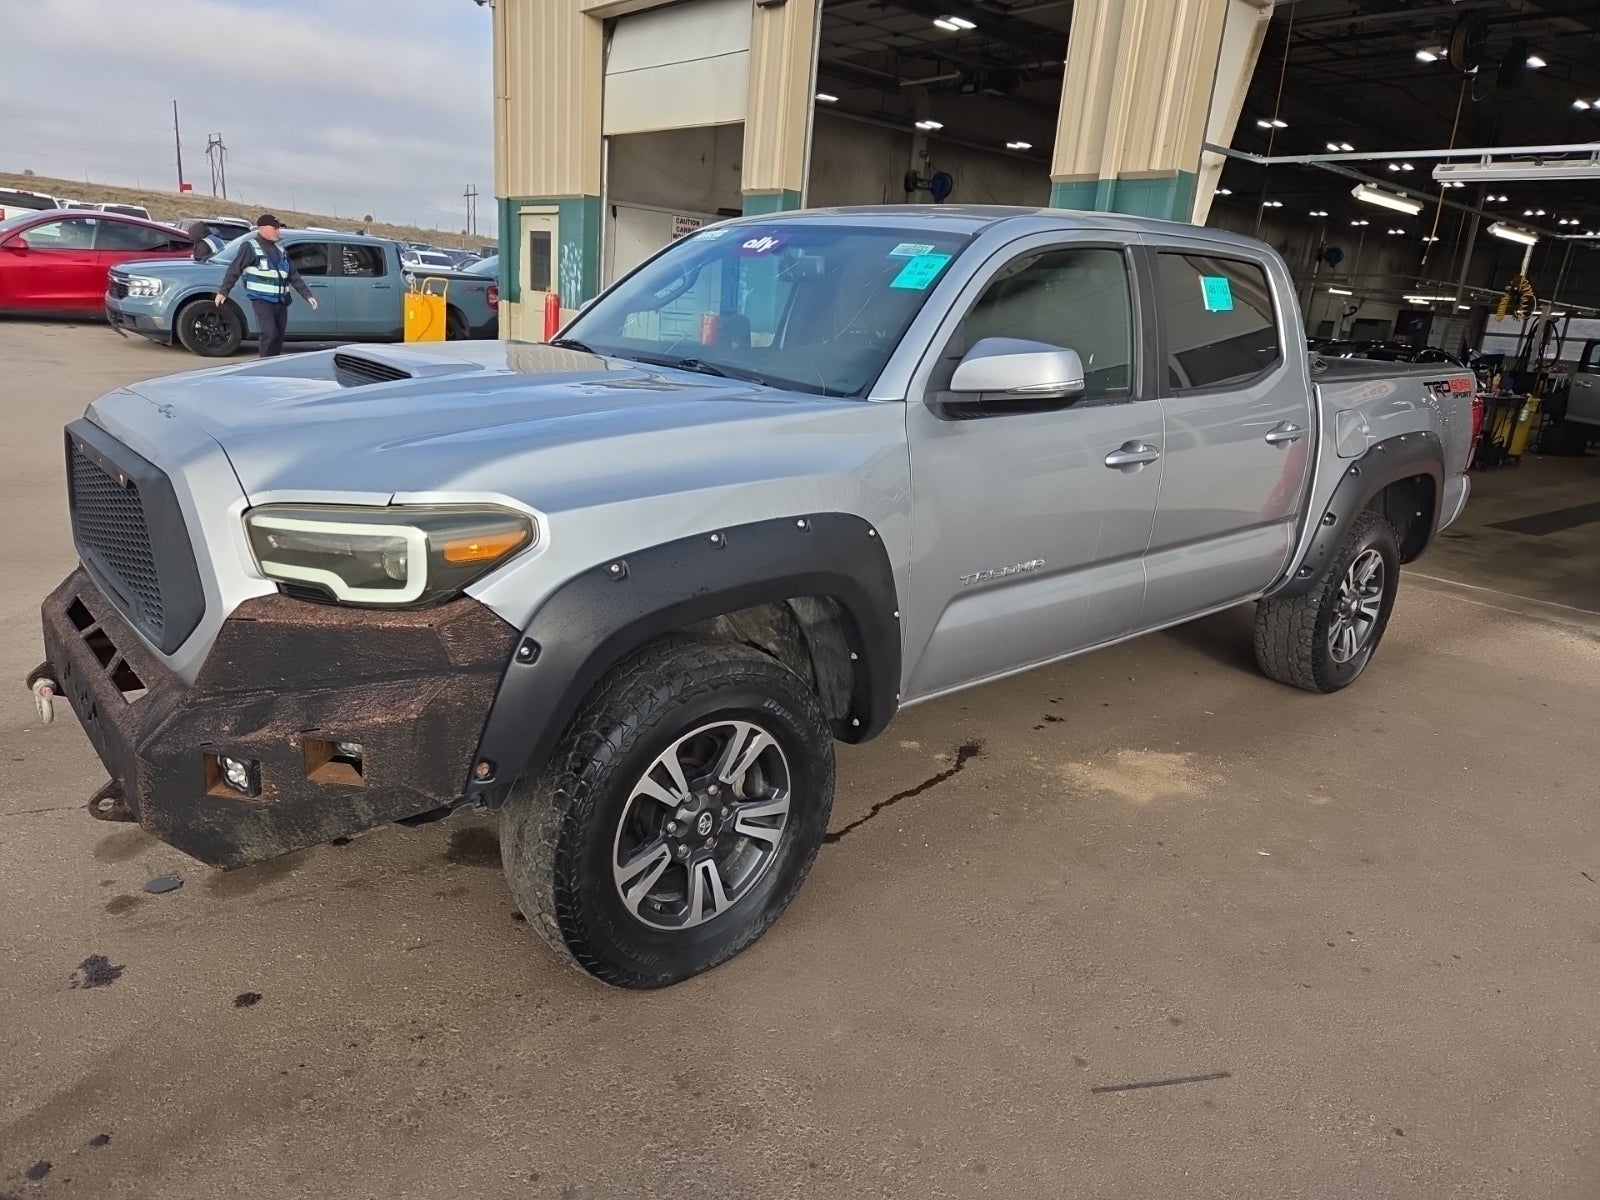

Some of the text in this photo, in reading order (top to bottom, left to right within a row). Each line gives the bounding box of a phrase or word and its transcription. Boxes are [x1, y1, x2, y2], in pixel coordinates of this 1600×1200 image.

[675, 217, 700, 227] CAUTION
[742, 236, 779, 252] ally
[1423, 380, 1452, 398] TRD
[960, 559, 1045, 584] TACOMA
